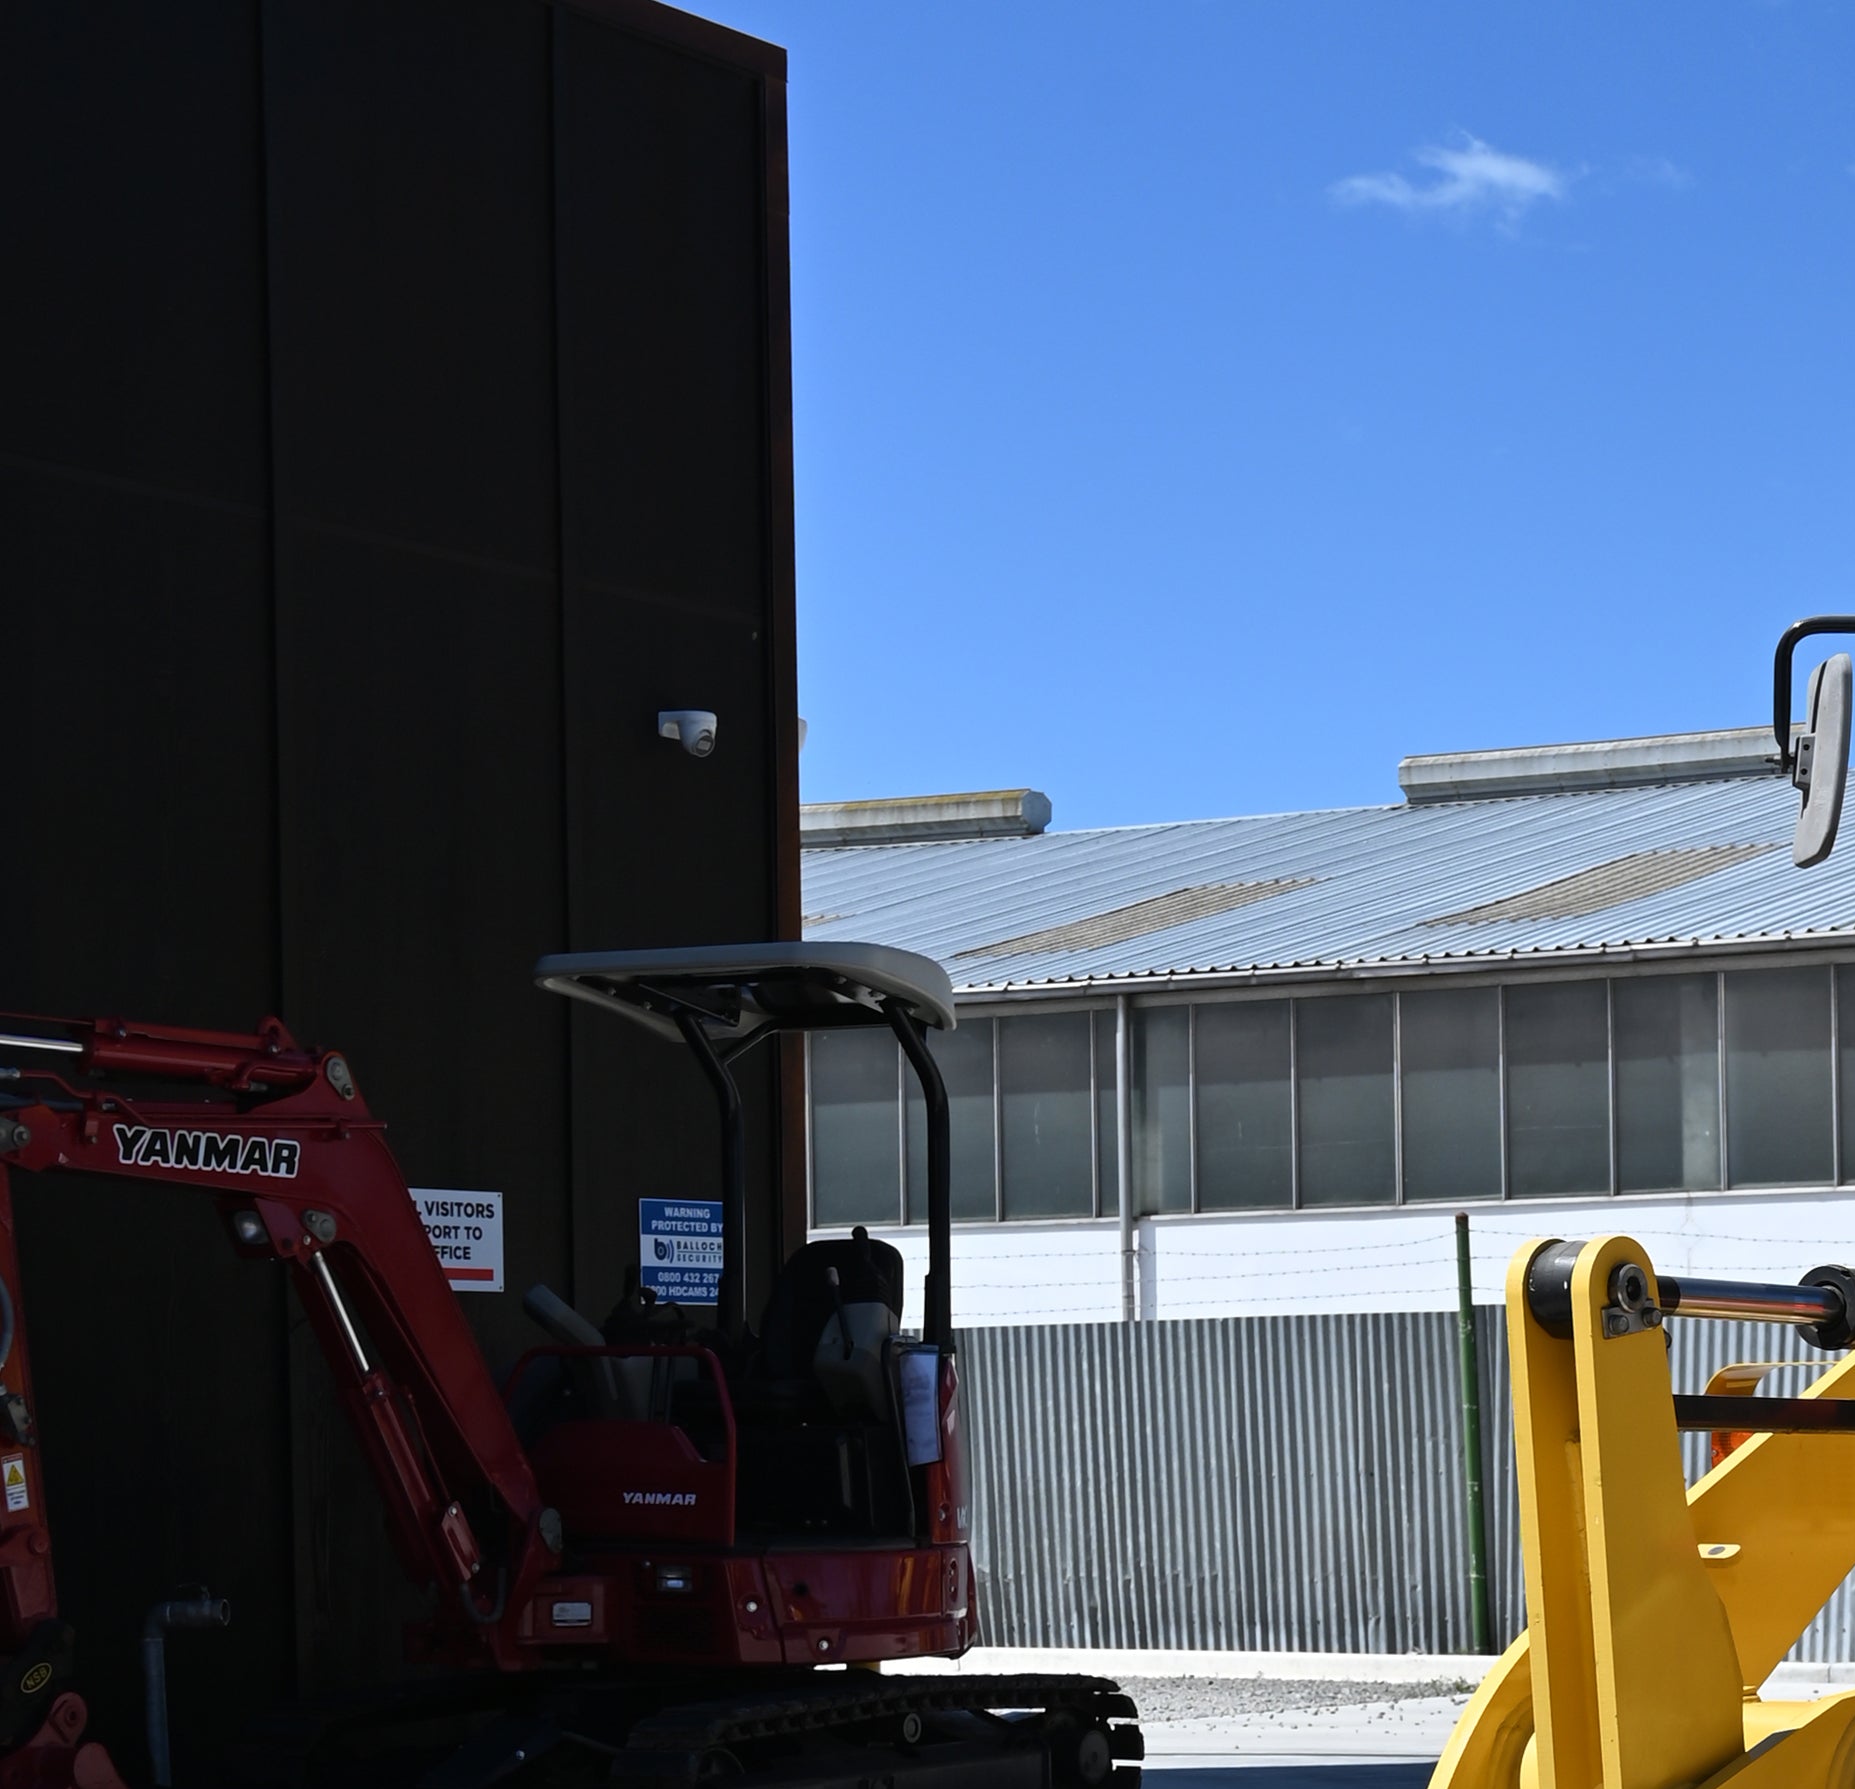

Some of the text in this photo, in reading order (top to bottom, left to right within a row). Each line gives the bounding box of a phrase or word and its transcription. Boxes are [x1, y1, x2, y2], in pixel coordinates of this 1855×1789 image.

[113, 1124, 300, 1179] YANMAR
[424, 1200, 495, 1219] VISITORS
[664, 1207, 711, 1219] WARNING
[424, 1225, 483, 1240] PORT TO
[651, 1220, 724, 1233] PROTECTED BY
[431, 1245, 471, 1260] FFICE
[676, 1241, 723, 1251] BALLOCH
[676, 1254, 722, 1263] SECURITY
[682, 1273, 701, 1283] 432
[668, 1286, 708, 1297] HDCAMS
[622, 1491, 697, 1506] YANMAR
